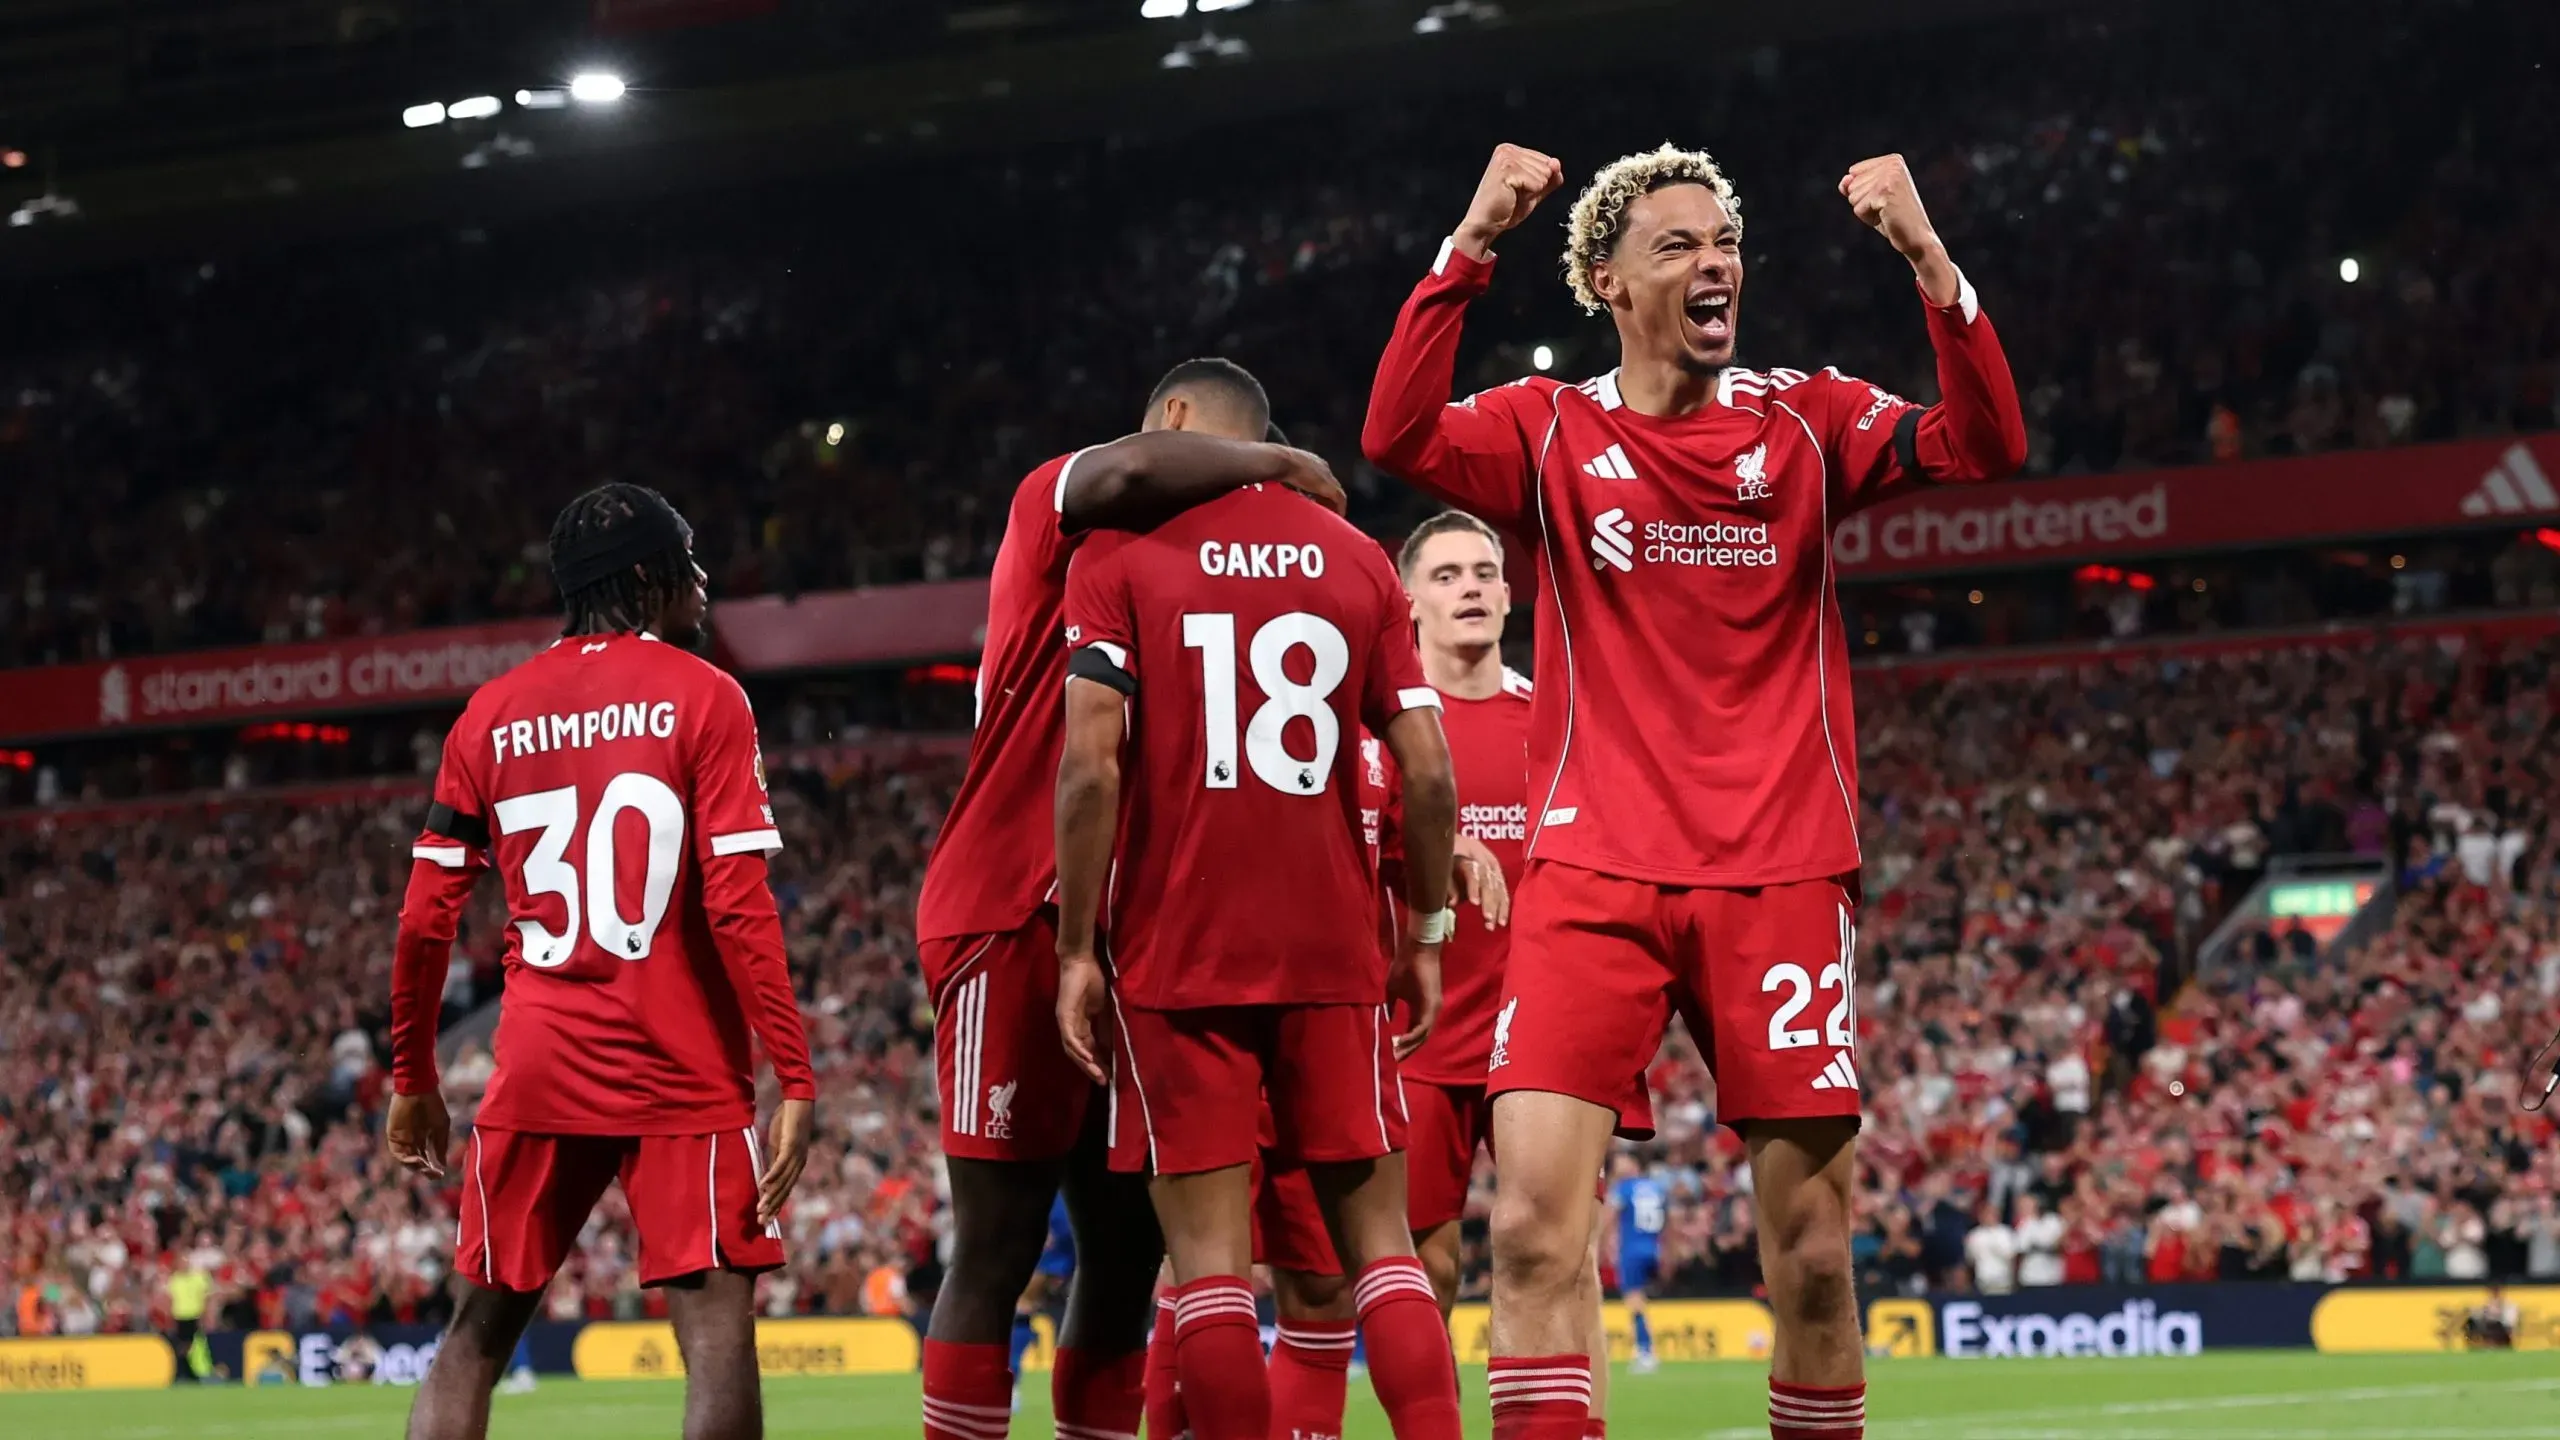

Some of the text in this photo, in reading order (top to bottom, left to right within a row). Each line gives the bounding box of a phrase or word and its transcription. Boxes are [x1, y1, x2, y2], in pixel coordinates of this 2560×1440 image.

[1644, 520, 1767, 545] standard
[1880, 484, 2167, 559] chartered
[1199, 541, 1325, 578] GAKPO
[1644, 541, 1777, 567] chartered
[141, 653, 341, 715] standard
[1182, 612, 1350, 796] 18
[491, 701, 676, 764] FRIMPONG
[1461, 821, 1525, 840] charte
[493, 772, 685, 967] 30
[1761, 962, 1855, 1050] 22
[1942, 1298, 2203, 1359] Expedia
